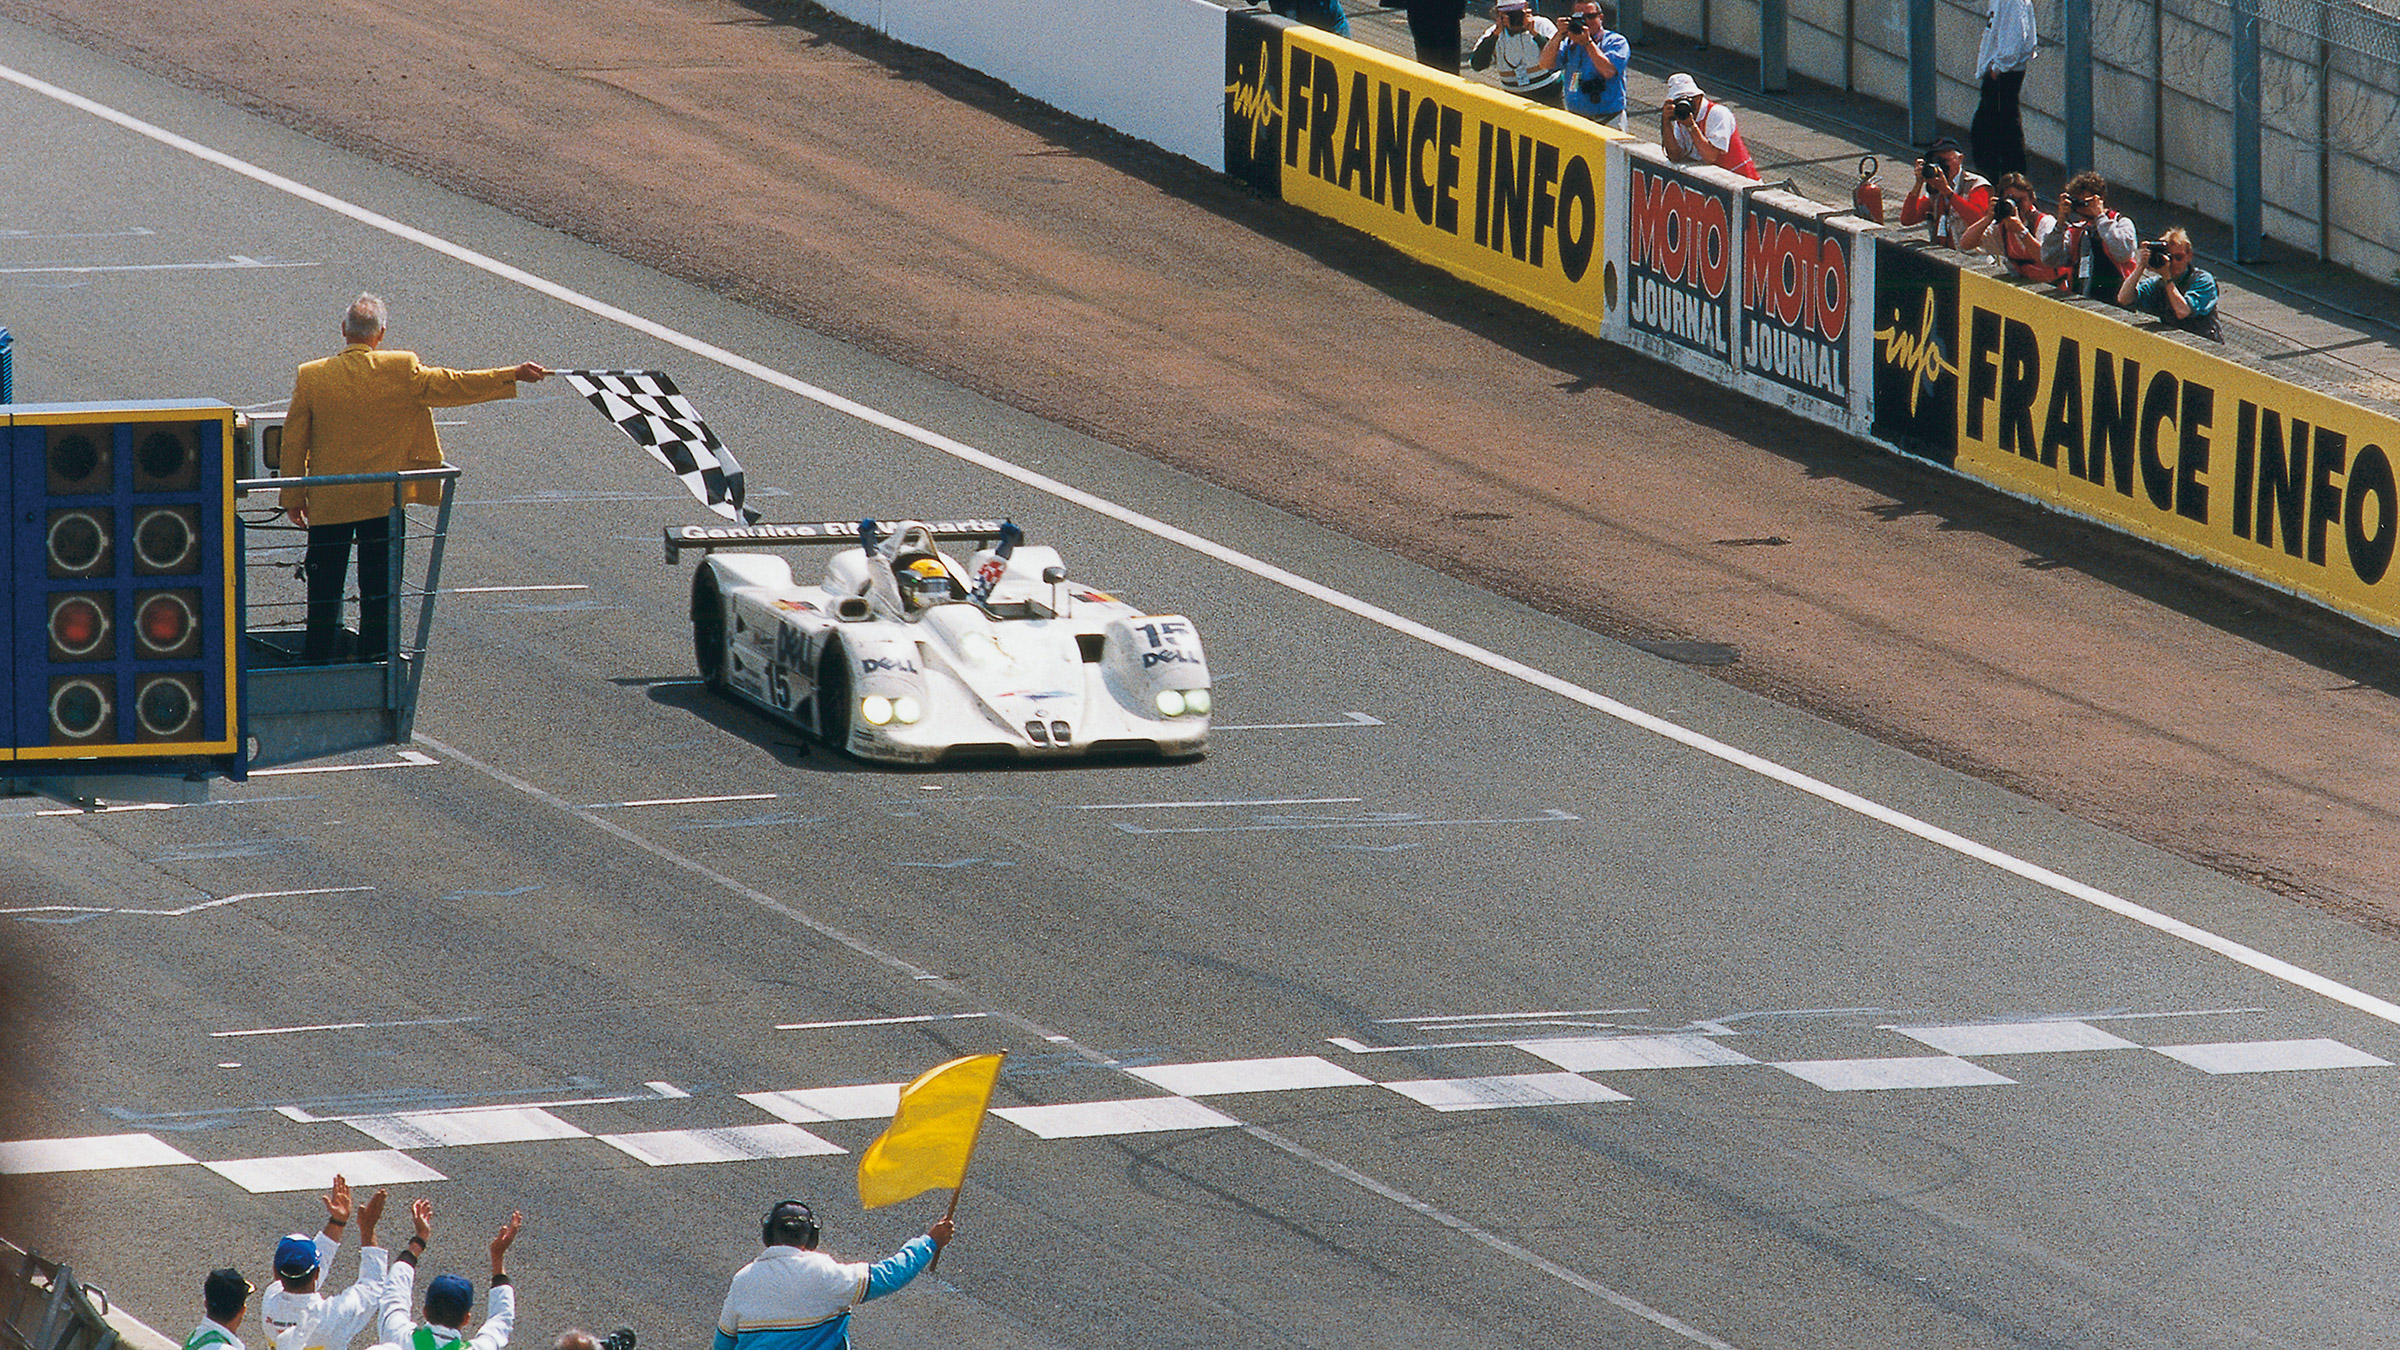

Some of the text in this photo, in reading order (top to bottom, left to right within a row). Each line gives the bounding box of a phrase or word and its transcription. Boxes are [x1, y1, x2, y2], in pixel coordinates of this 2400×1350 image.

[1226, 40, 1283, 159] info
[1285, 45, 1596, 283] FRANCE INFO
[1631, 168, 1730, 299] MOTO
[1631, 275, 1727, 354] JOURNAL
[1744, 211, 1849, 343] MOTO
[1744, 320, 1846, 398] JOURNAL
[1874, 286, 1959, 418] info
[1965, 305, 2398, 586] FRANCE INFO
[681, 524, 817, 539] Genuine
[777, 620, 815, 680] DELL
[861, 656, 918, 674] DELL
[1135, 622, 1189, 648] 15
[1142, 649, 1200, 668] DELL
[764, 660, 791, 709] 15
